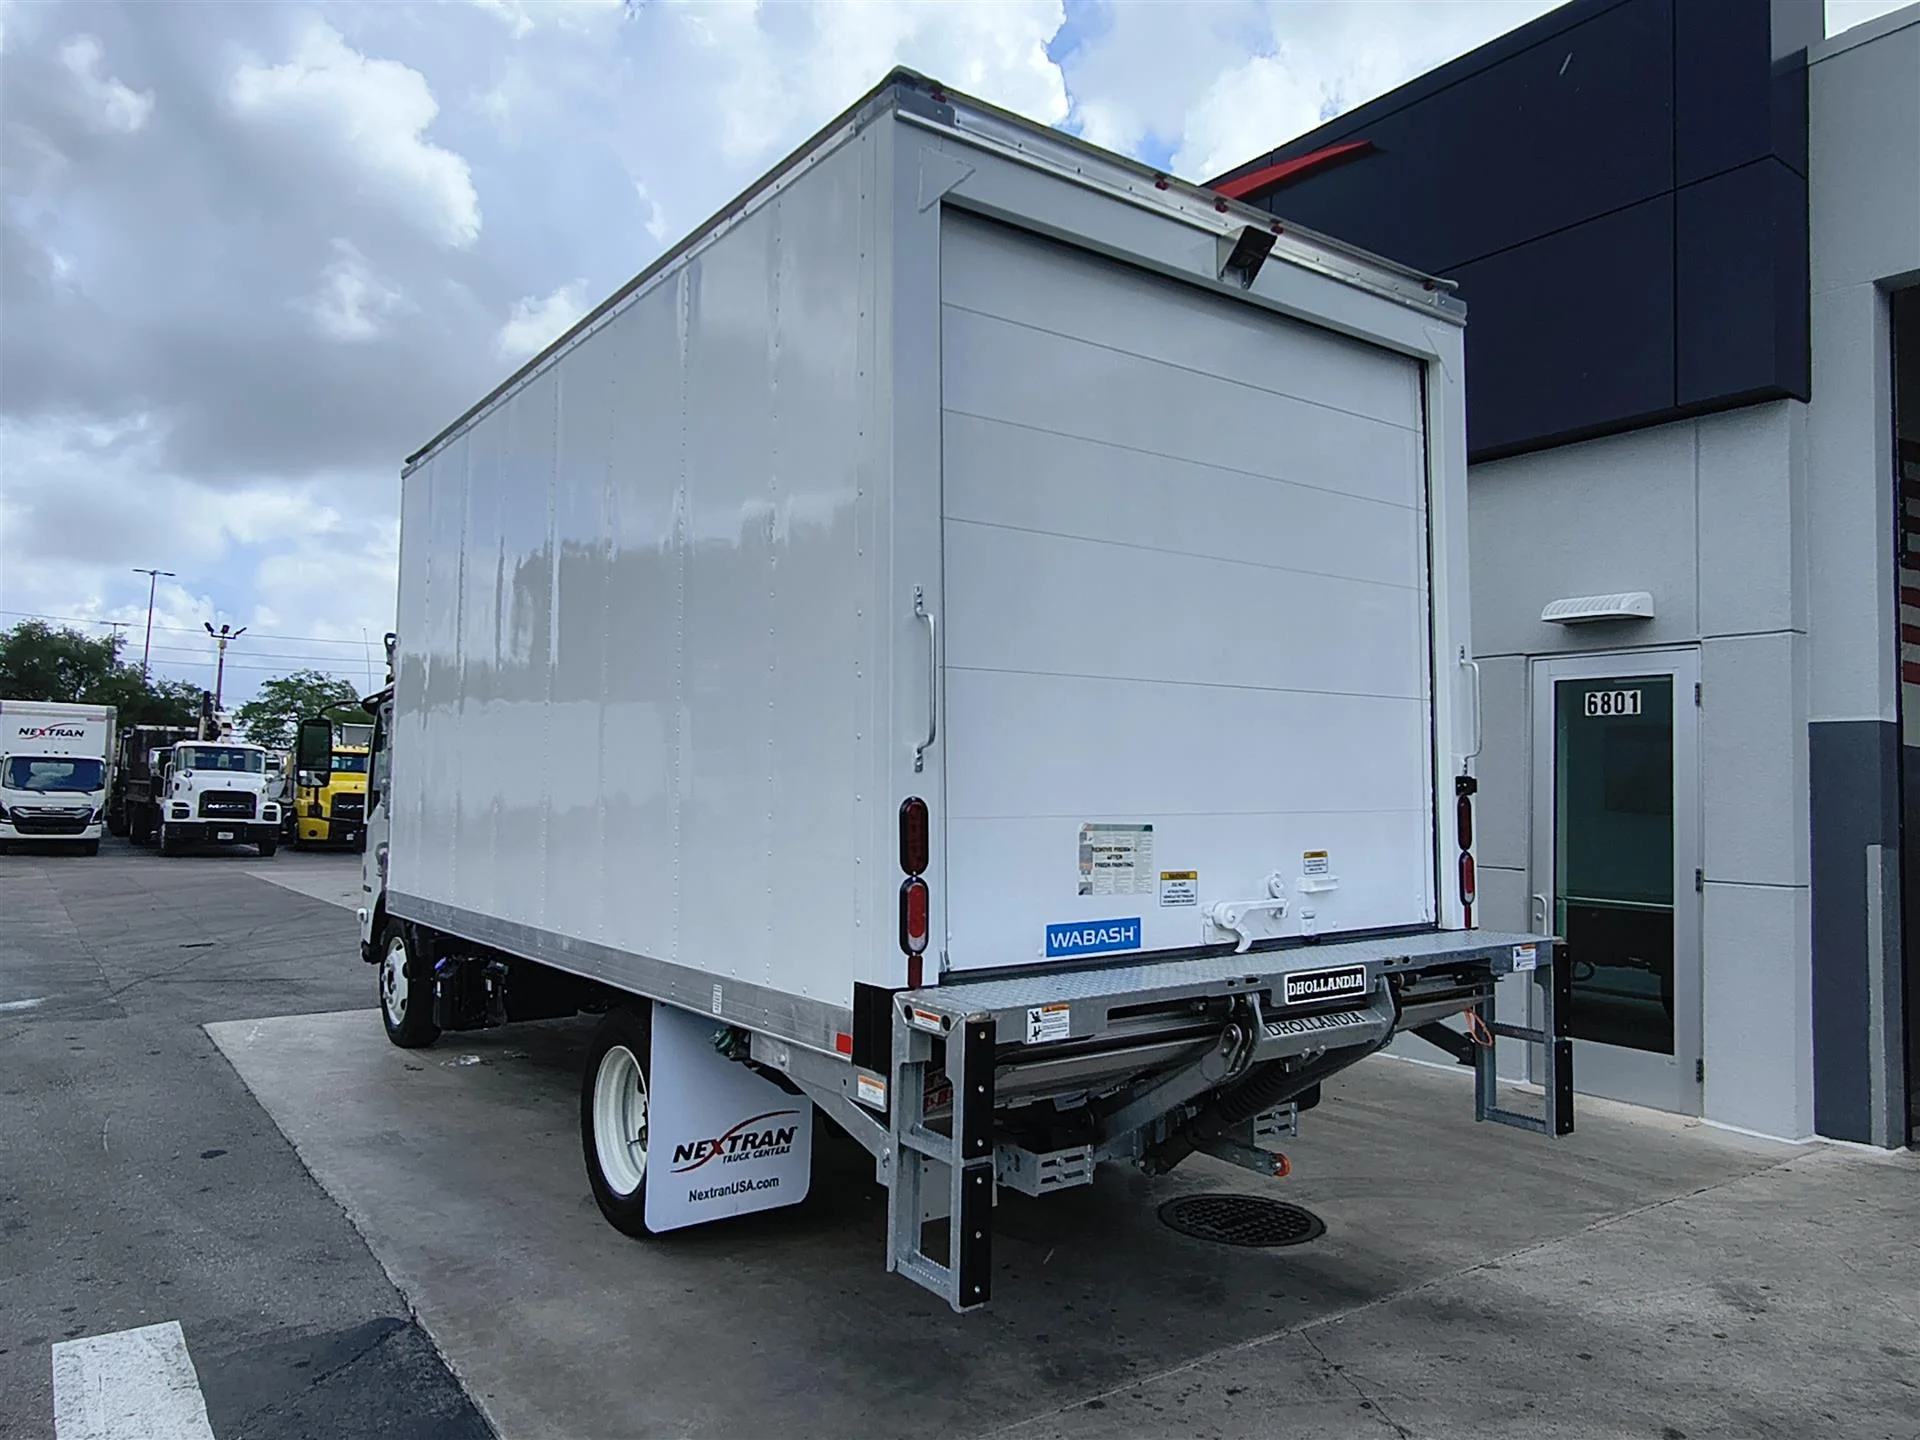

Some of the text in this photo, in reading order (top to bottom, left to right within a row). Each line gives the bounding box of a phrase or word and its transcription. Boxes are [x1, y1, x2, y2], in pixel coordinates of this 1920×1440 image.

[1588, 691, 1638, 715] 6801
[18, 727, 85, 738] NEXTRAN
[1050, 926, 1135, 948] WABASH
[1287, 973, 1364, 996] DHOLLANDIA
[1265, 1010, 1367, 1037] DHOLLANDIA
[672, 1126, 797, 1163] NEXTRAN
[722, 1145, 791, 1164] TRUCK CENTERS
[688, 1176, 780, 1203] NextranUSA.com
